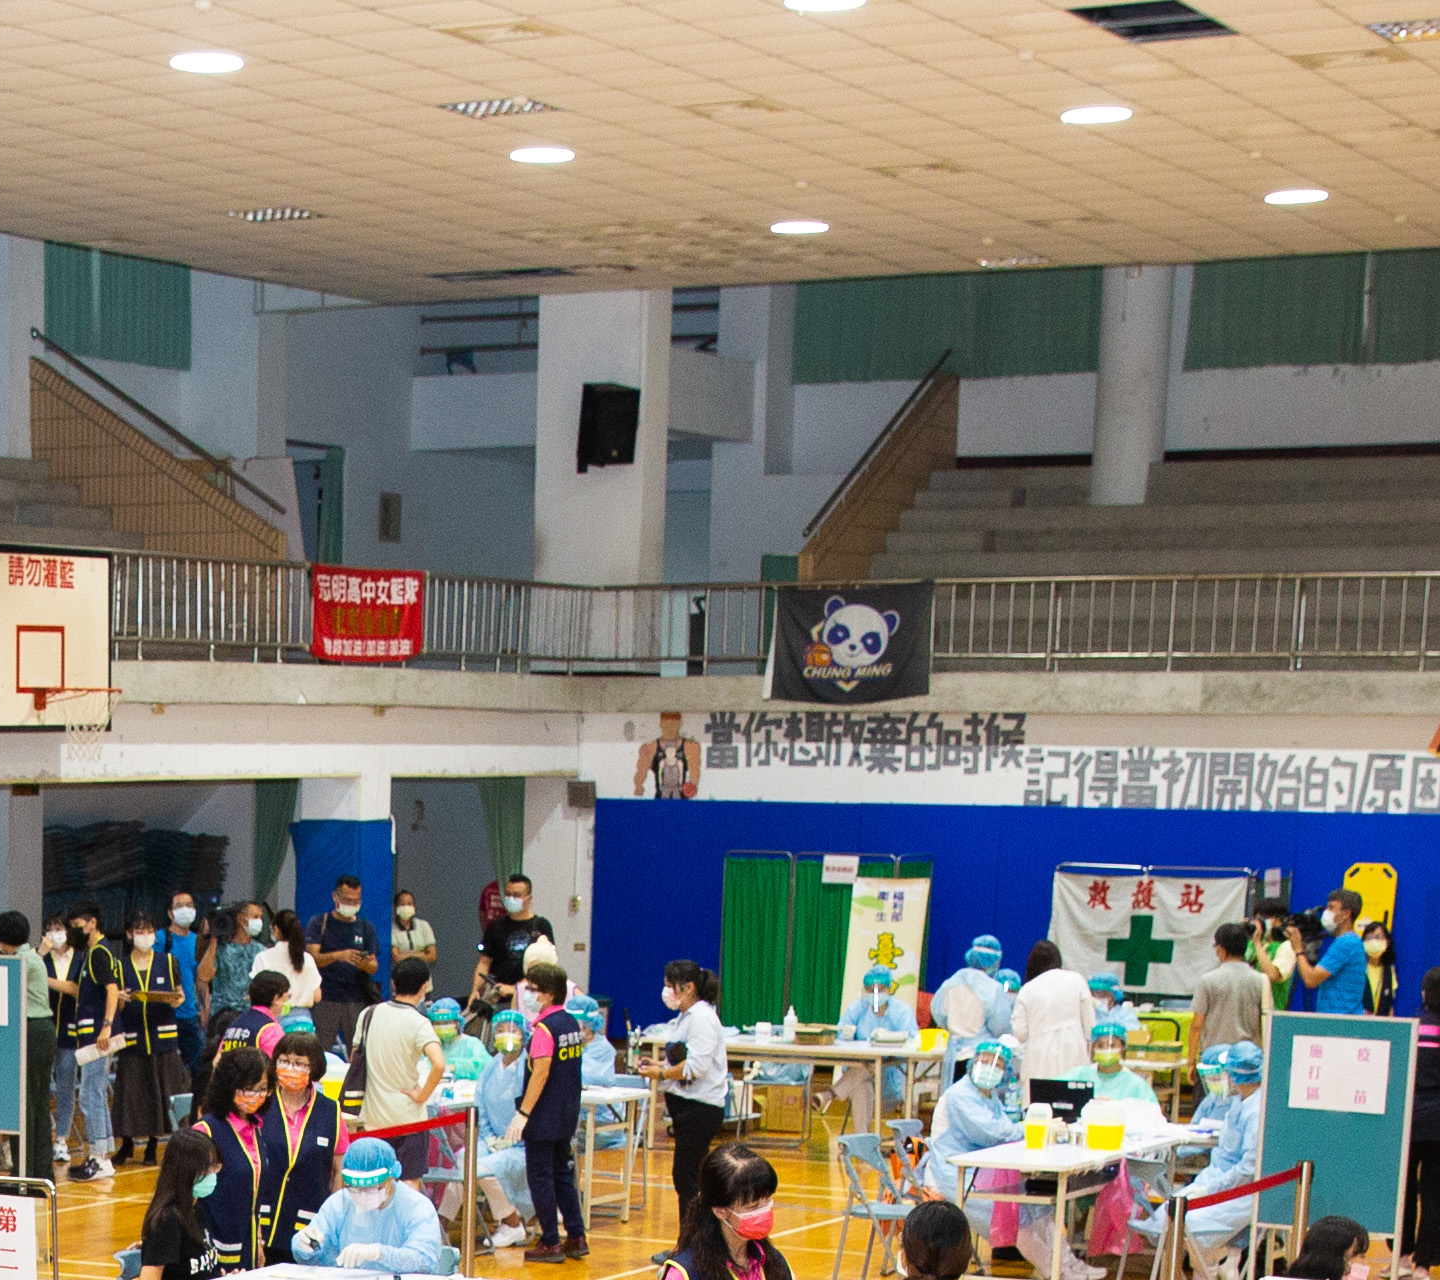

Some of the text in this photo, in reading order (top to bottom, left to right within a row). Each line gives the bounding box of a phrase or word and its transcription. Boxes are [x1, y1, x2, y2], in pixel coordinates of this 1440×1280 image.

[7, 554, 75, 590] 請勿灌籃
[803, 662, 893, 680] CHUNG MING
[705, 711, 1026, 774] 當你想放棄的時候
[1088, 879, 1204, 914] 救護站
